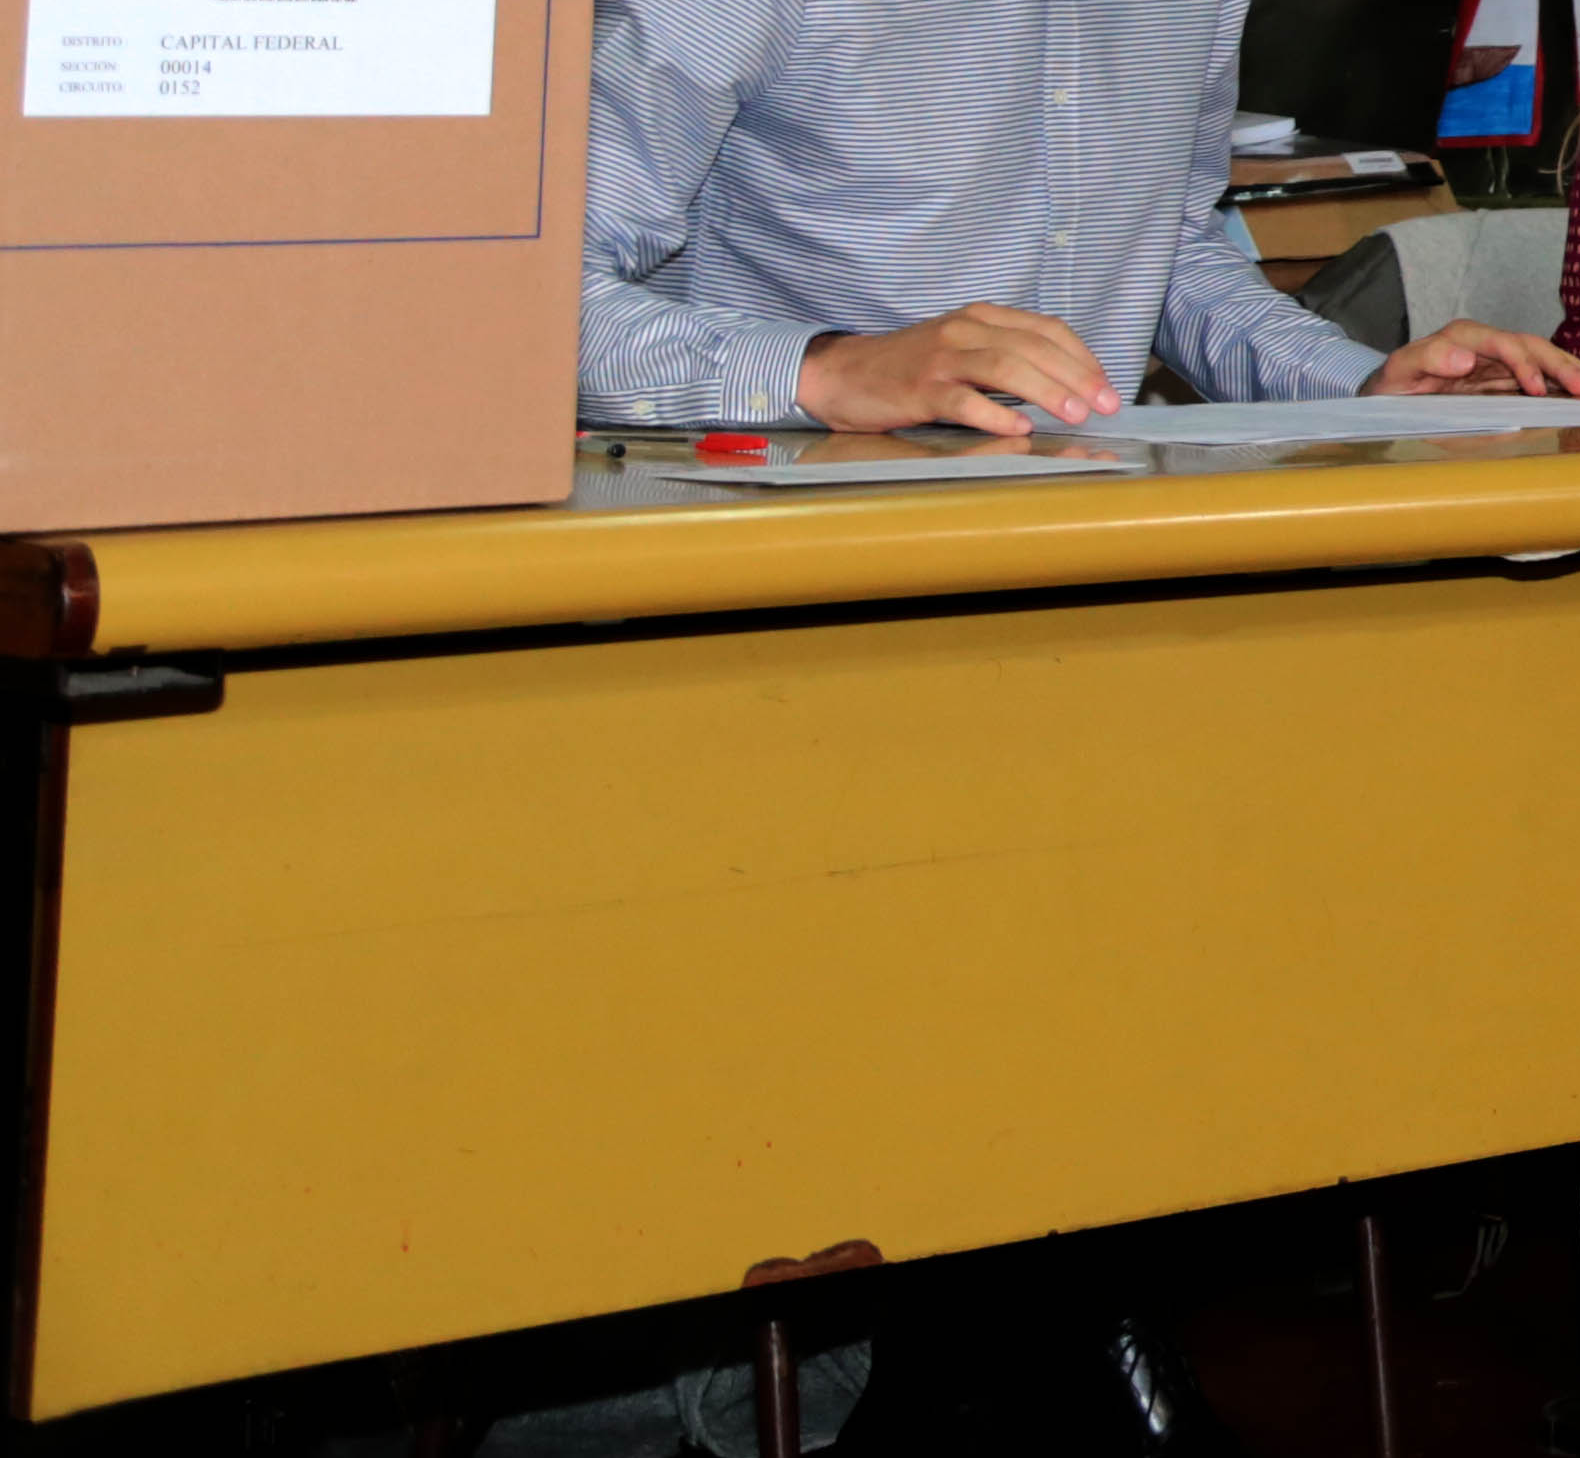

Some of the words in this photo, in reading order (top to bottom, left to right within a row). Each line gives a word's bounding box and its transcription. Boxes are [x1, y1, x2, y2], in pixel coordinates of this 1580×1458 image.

[160, 35, 247, 50] CAPITAL
[253, 35, 343, 50] FEDERAL
[160, 60, 212, 75] 00014
[159, 80, 200, 95] 0152
